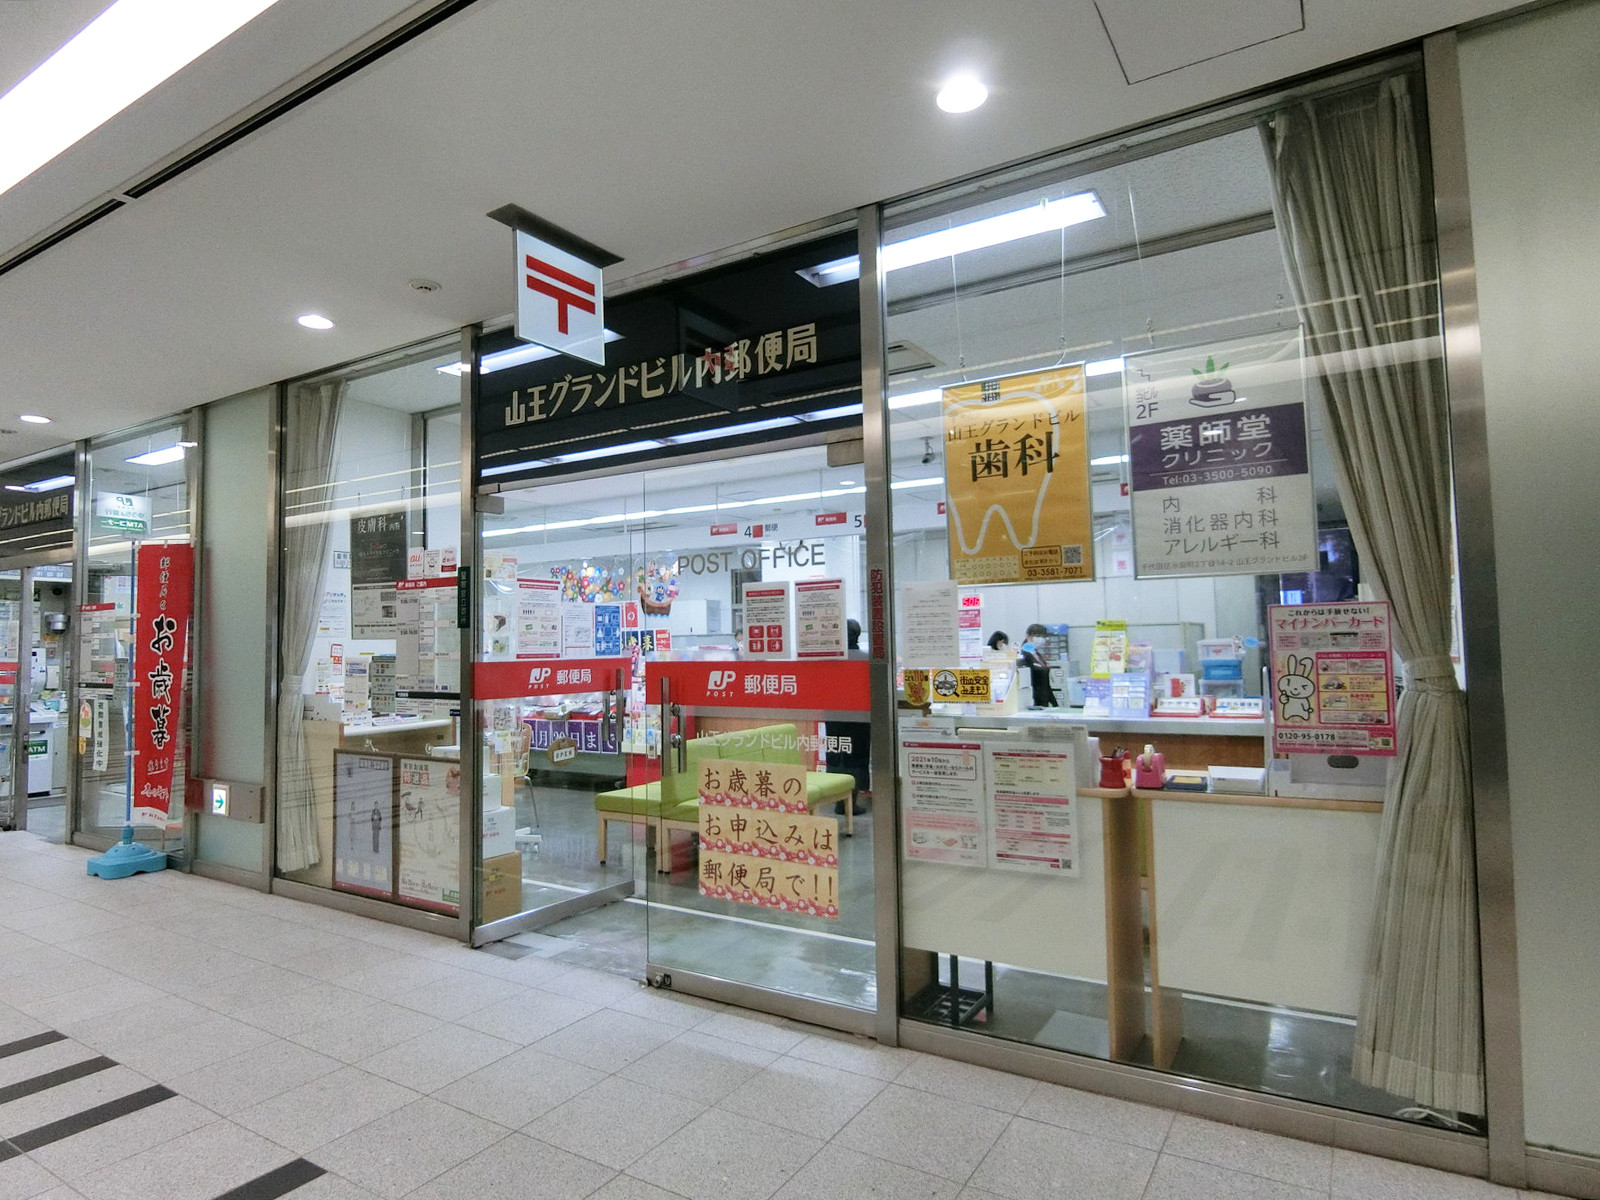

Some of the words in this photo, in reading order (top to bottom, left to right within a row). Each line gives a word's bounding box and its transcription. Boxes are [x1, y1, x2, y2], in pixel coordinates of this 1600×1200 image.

[505, 323, 817, 426] 山王グランドビル内郵便局
[1136, 402, 1158, 419] 2F
[948, 409, 1080, 441] 山王グランドビル
[1160, 414, 1272, 451] 薬師堂
[968, 430, 1060, 482] 歯科
[1162, 442, 1272, 468] クリニック
[744, 526, 752, 537] 4
[854, 515, 862, 528] 5
[1163, 508, 1278, 535] 消化器内科
[1164, 531, 1279, 556] アレルギー科
[678, 551, 733, 575] POST
[741, 543, 826, 570] OFFICE
[1275, 615, 1386, 630] マイナンバーカード
[149, 613, 178, 750] お歳暮
[556, 668, 592, 685] 郵便局
[744, 674, 797, 695] 郵便局
[29, 745, 46, 754] ATM
[696, 729, 853, 754] 山王グランドビル内郵便局
[704, 767, 802, 798] お歳暮の
[704, 812, 833, 851] お申込みは
